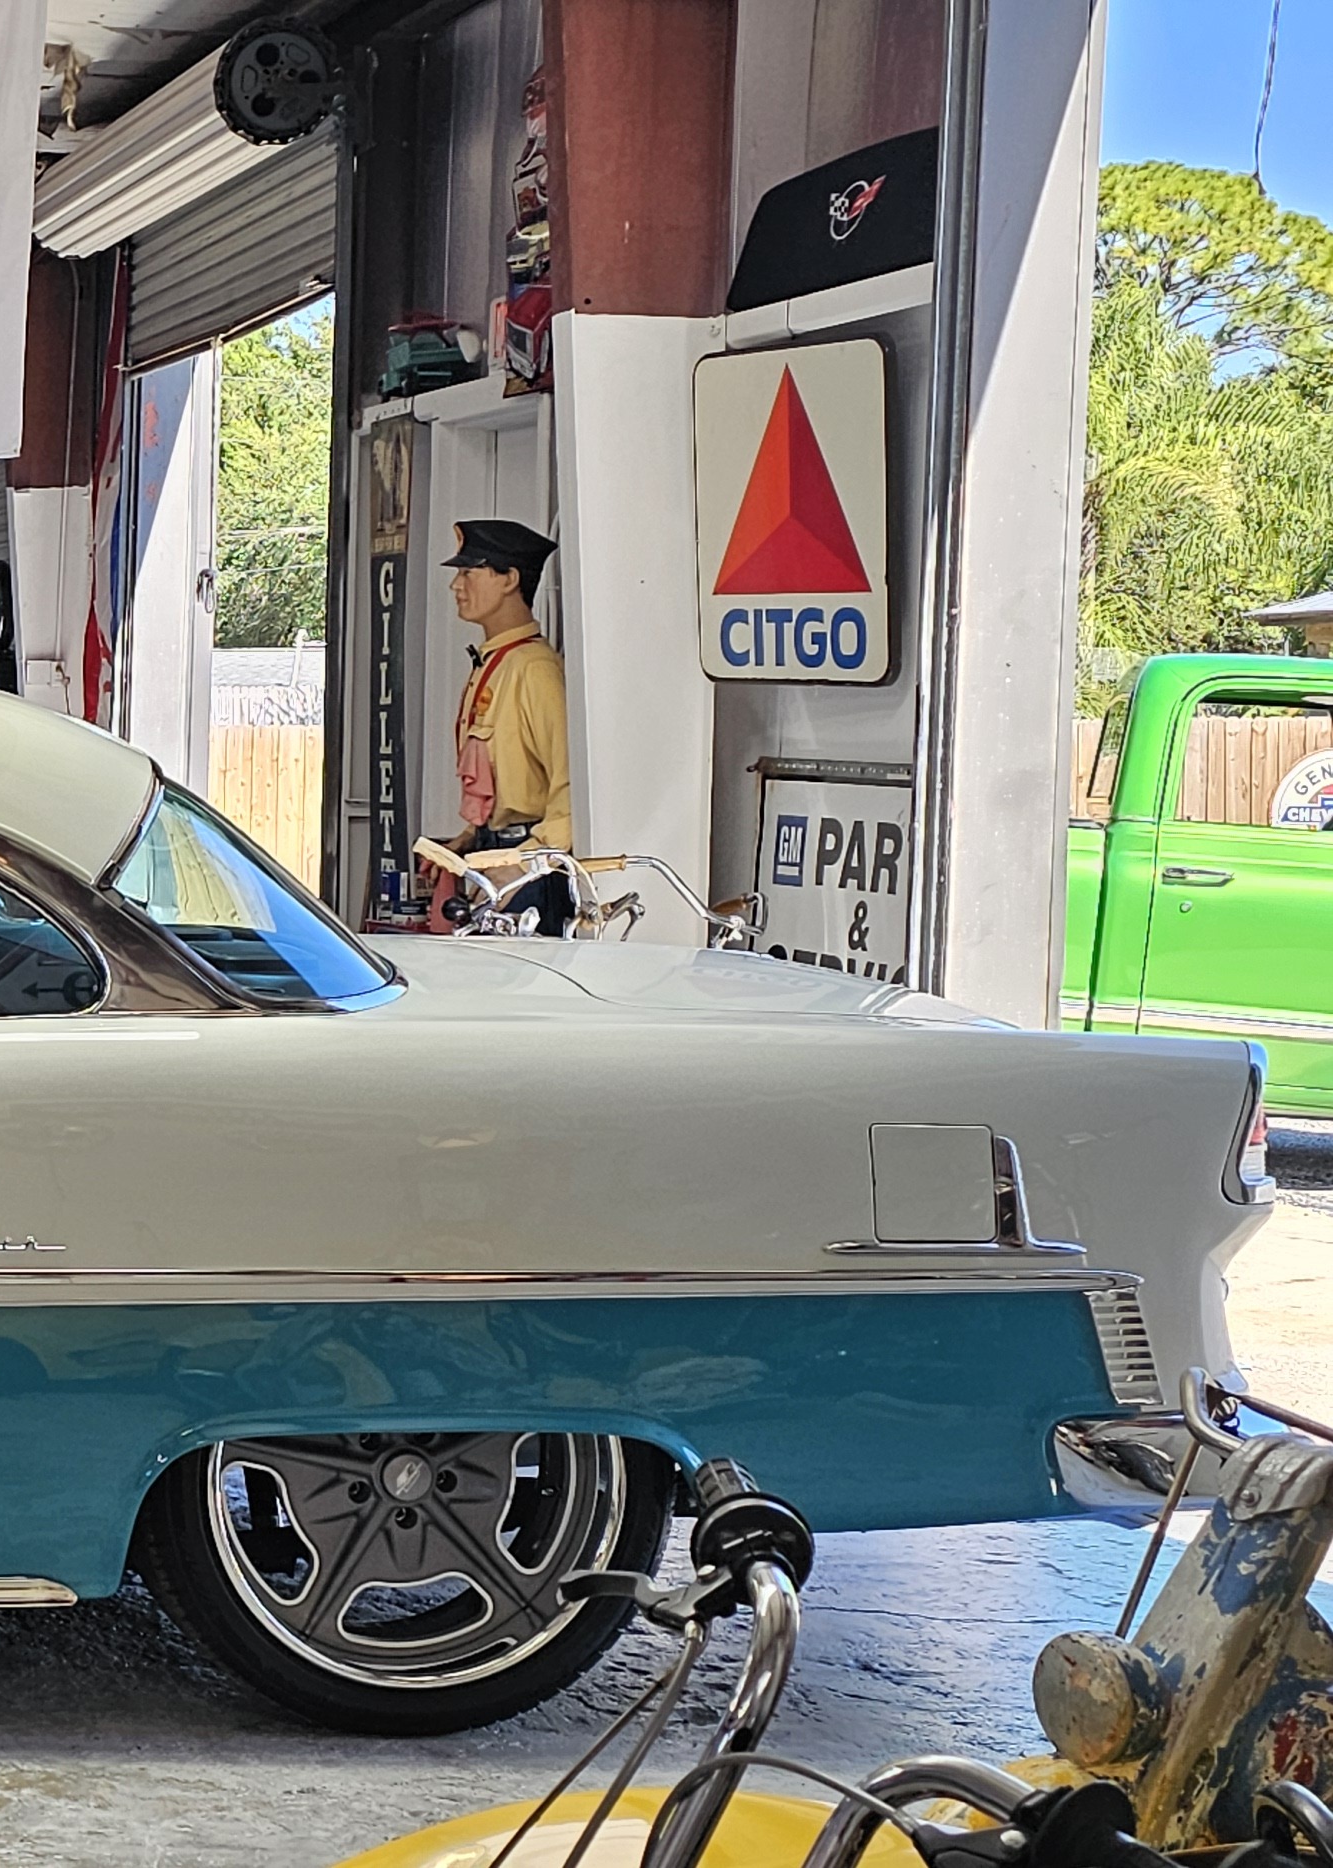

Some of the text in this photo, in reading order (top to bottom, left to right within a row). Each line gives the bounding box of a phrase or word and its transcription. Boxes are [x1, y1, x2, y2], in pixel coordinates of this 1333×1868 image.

[719, 606, 868, 671] CITGO
[778, 825, 803, 866] GM
[814, 816, 904, 895] PAR
[847, 899, 871, 952] &
